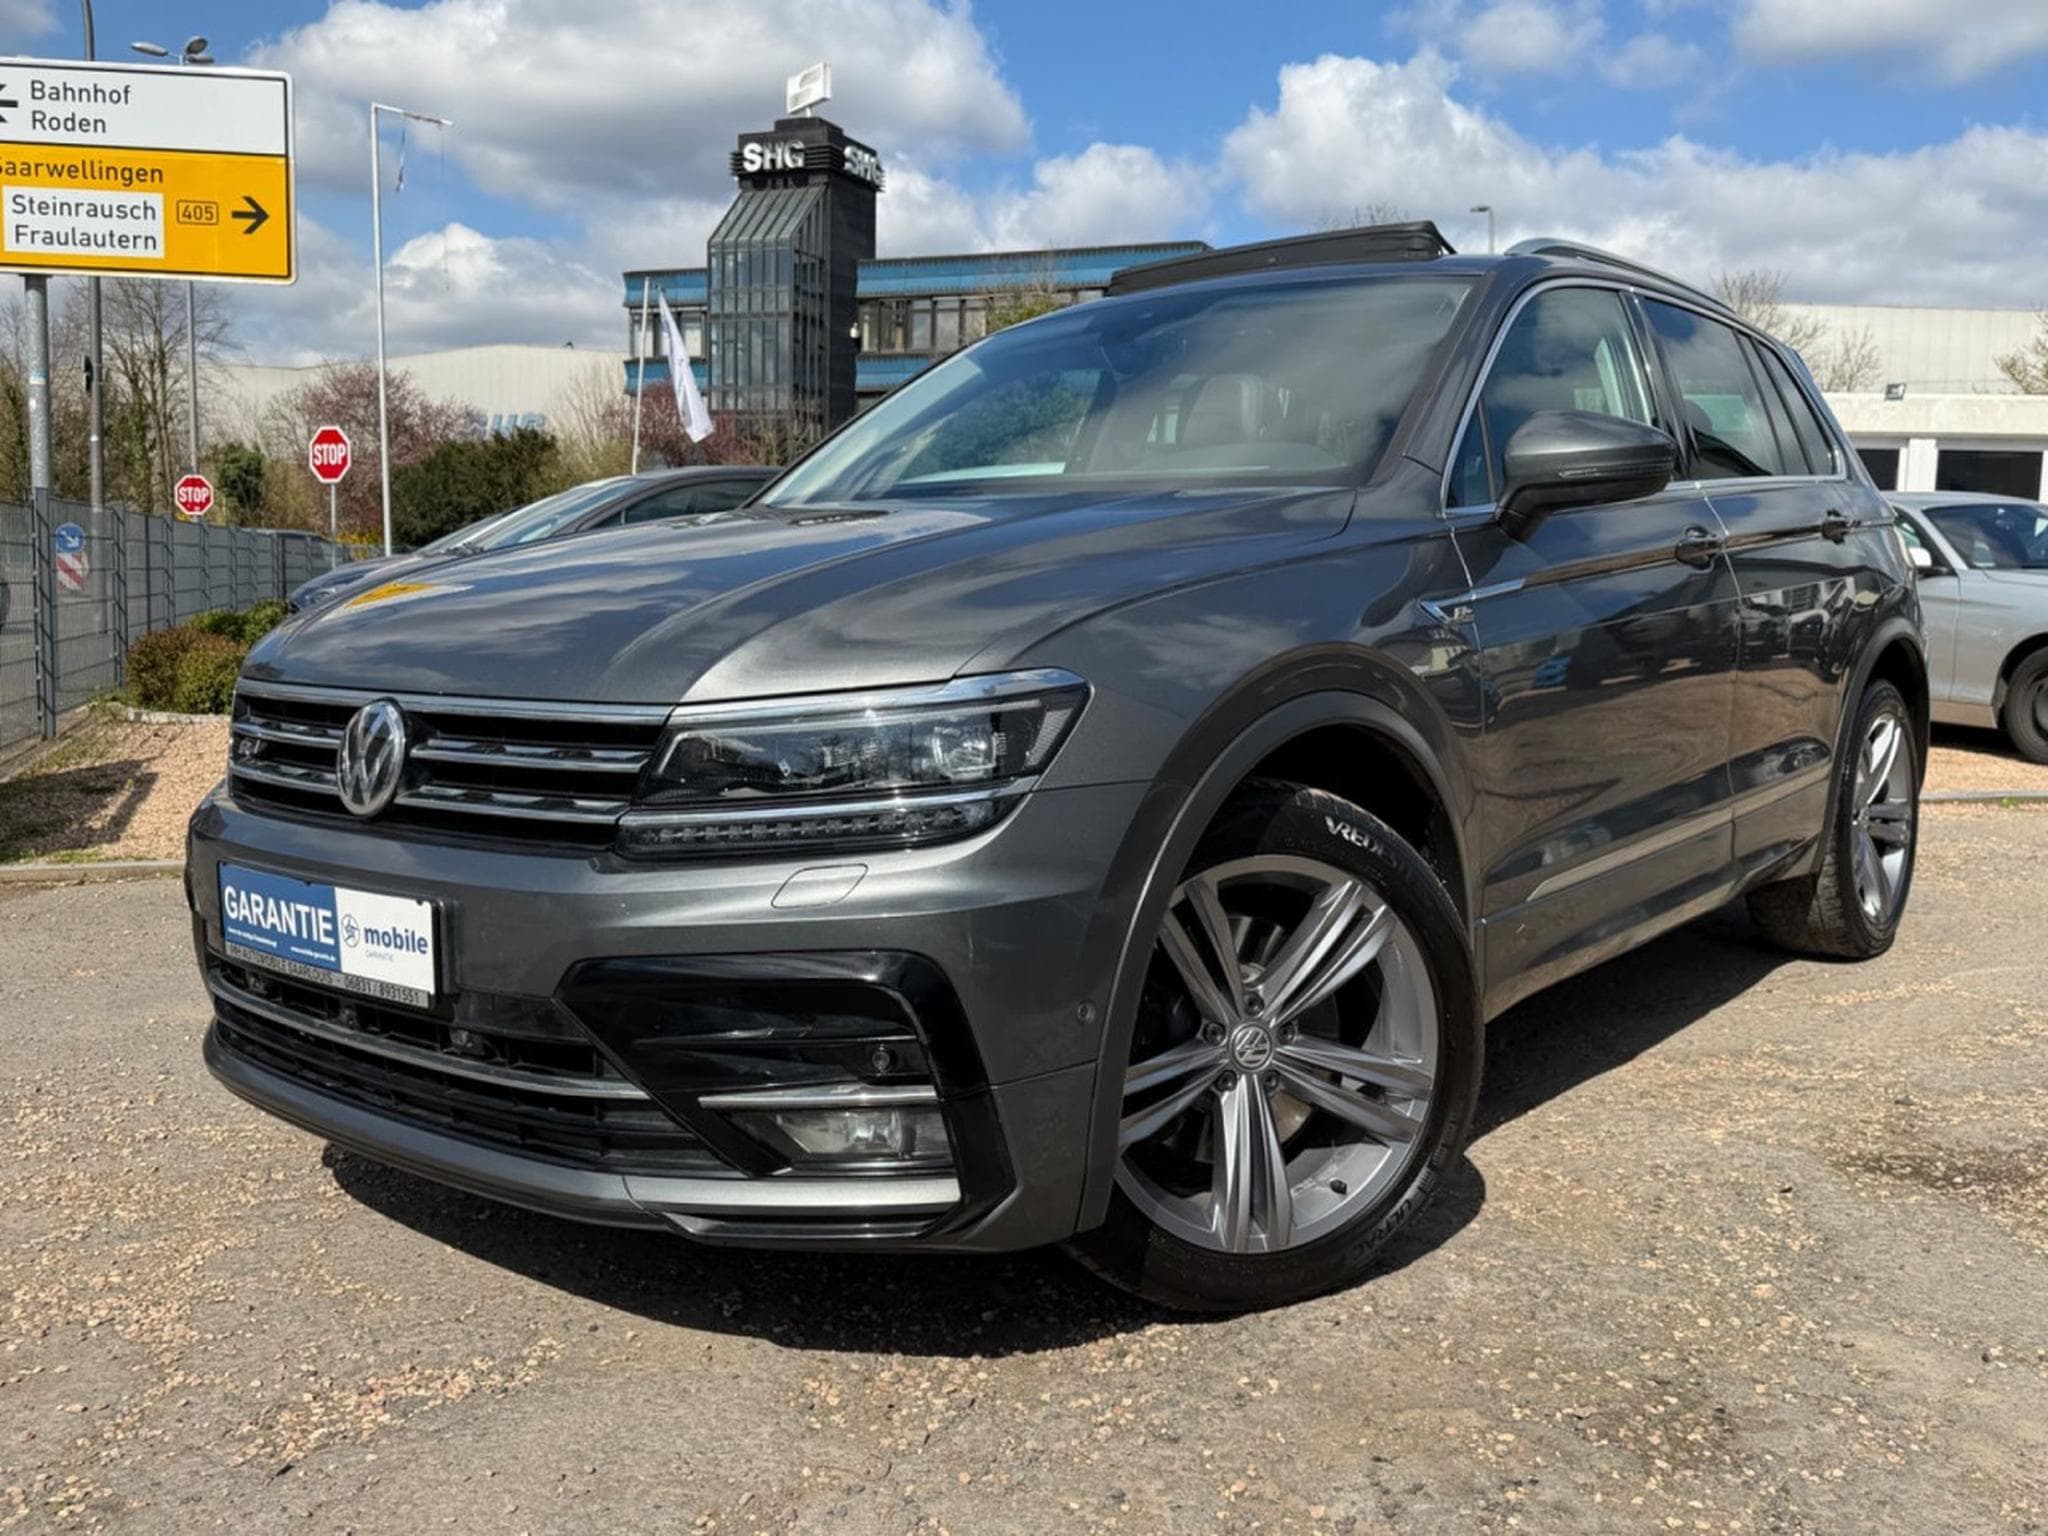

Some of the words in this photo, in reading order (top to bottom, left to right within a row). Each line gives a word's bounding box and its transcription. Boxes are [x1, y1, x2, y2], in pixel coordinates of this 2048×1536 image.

[31, 80, 131, 105] Bahnhof
[32, 110, 106, 133] Roden
[742, 140, 805, 172] SHG
[0, 155, 163, 187] aarwellingen
[12, 194, 156, 221] Steinrausch
[181, 204, 214, 221] 405
[15, 224, 157, 250] Fraulautern
[314, 443, 346, 466] STOP
[178, 486, 210, 502] STOP
[224, 885, 335, 945] GARANTIE
[364, 926, 428, 955] mobile
[344, 972, 372, 994] 06831
[379, 980, 420, 1004] 8931551
